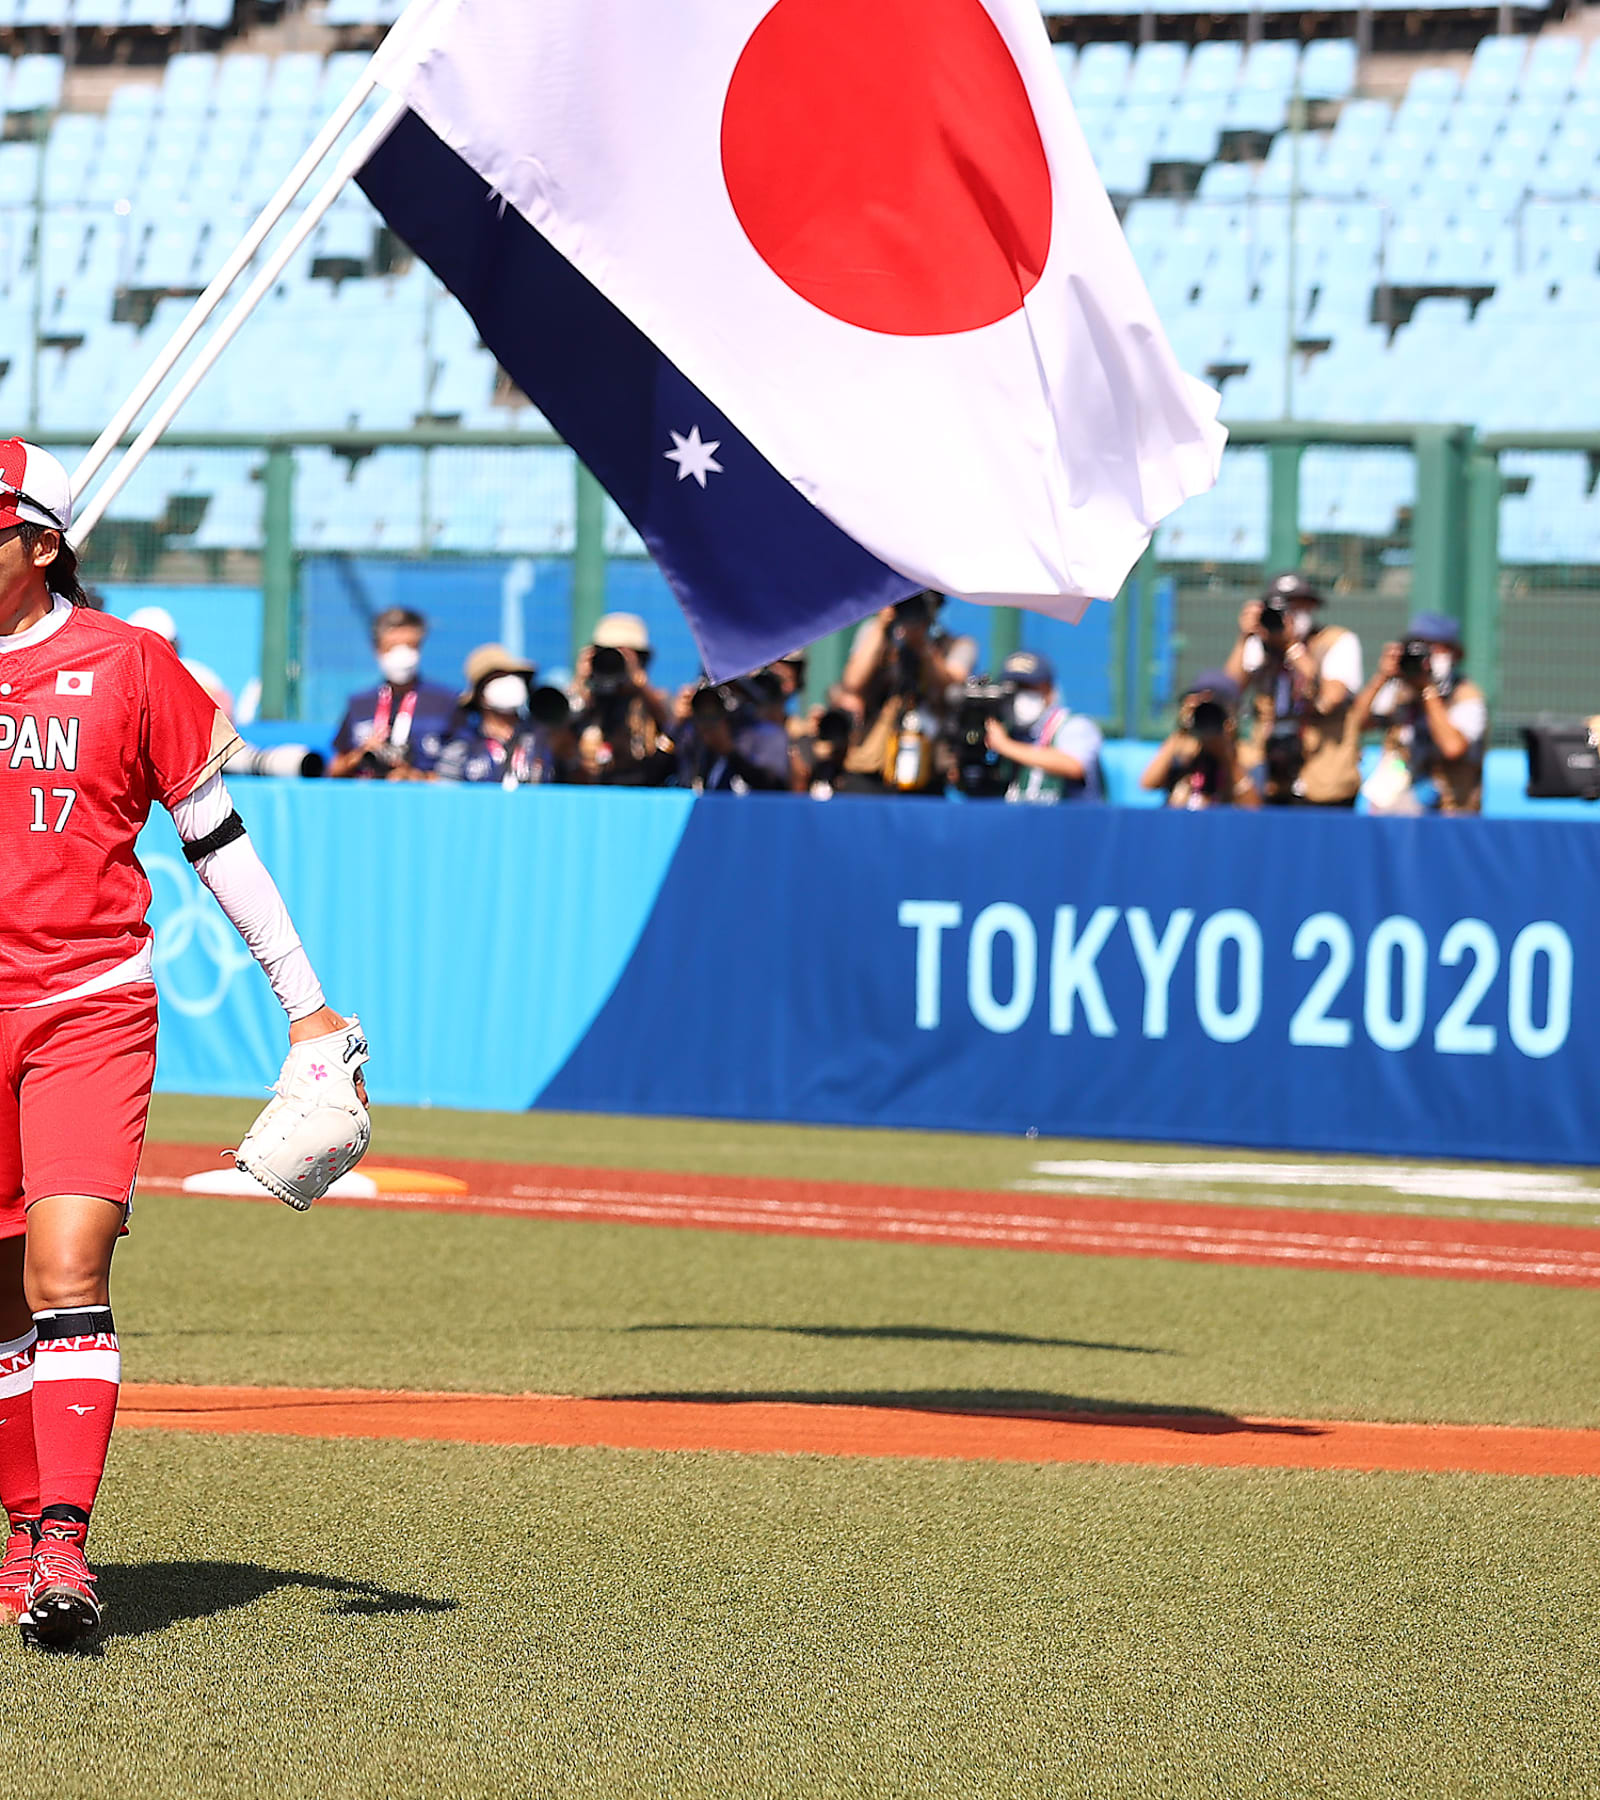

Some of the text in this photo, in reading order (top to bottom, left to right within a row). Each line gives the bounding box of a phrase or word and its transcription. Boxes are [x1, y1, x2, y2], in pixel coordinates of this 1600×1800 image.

[29, 786, 78, 834] 17
[898, 900, 1574, 1058] TOKYO 2020
